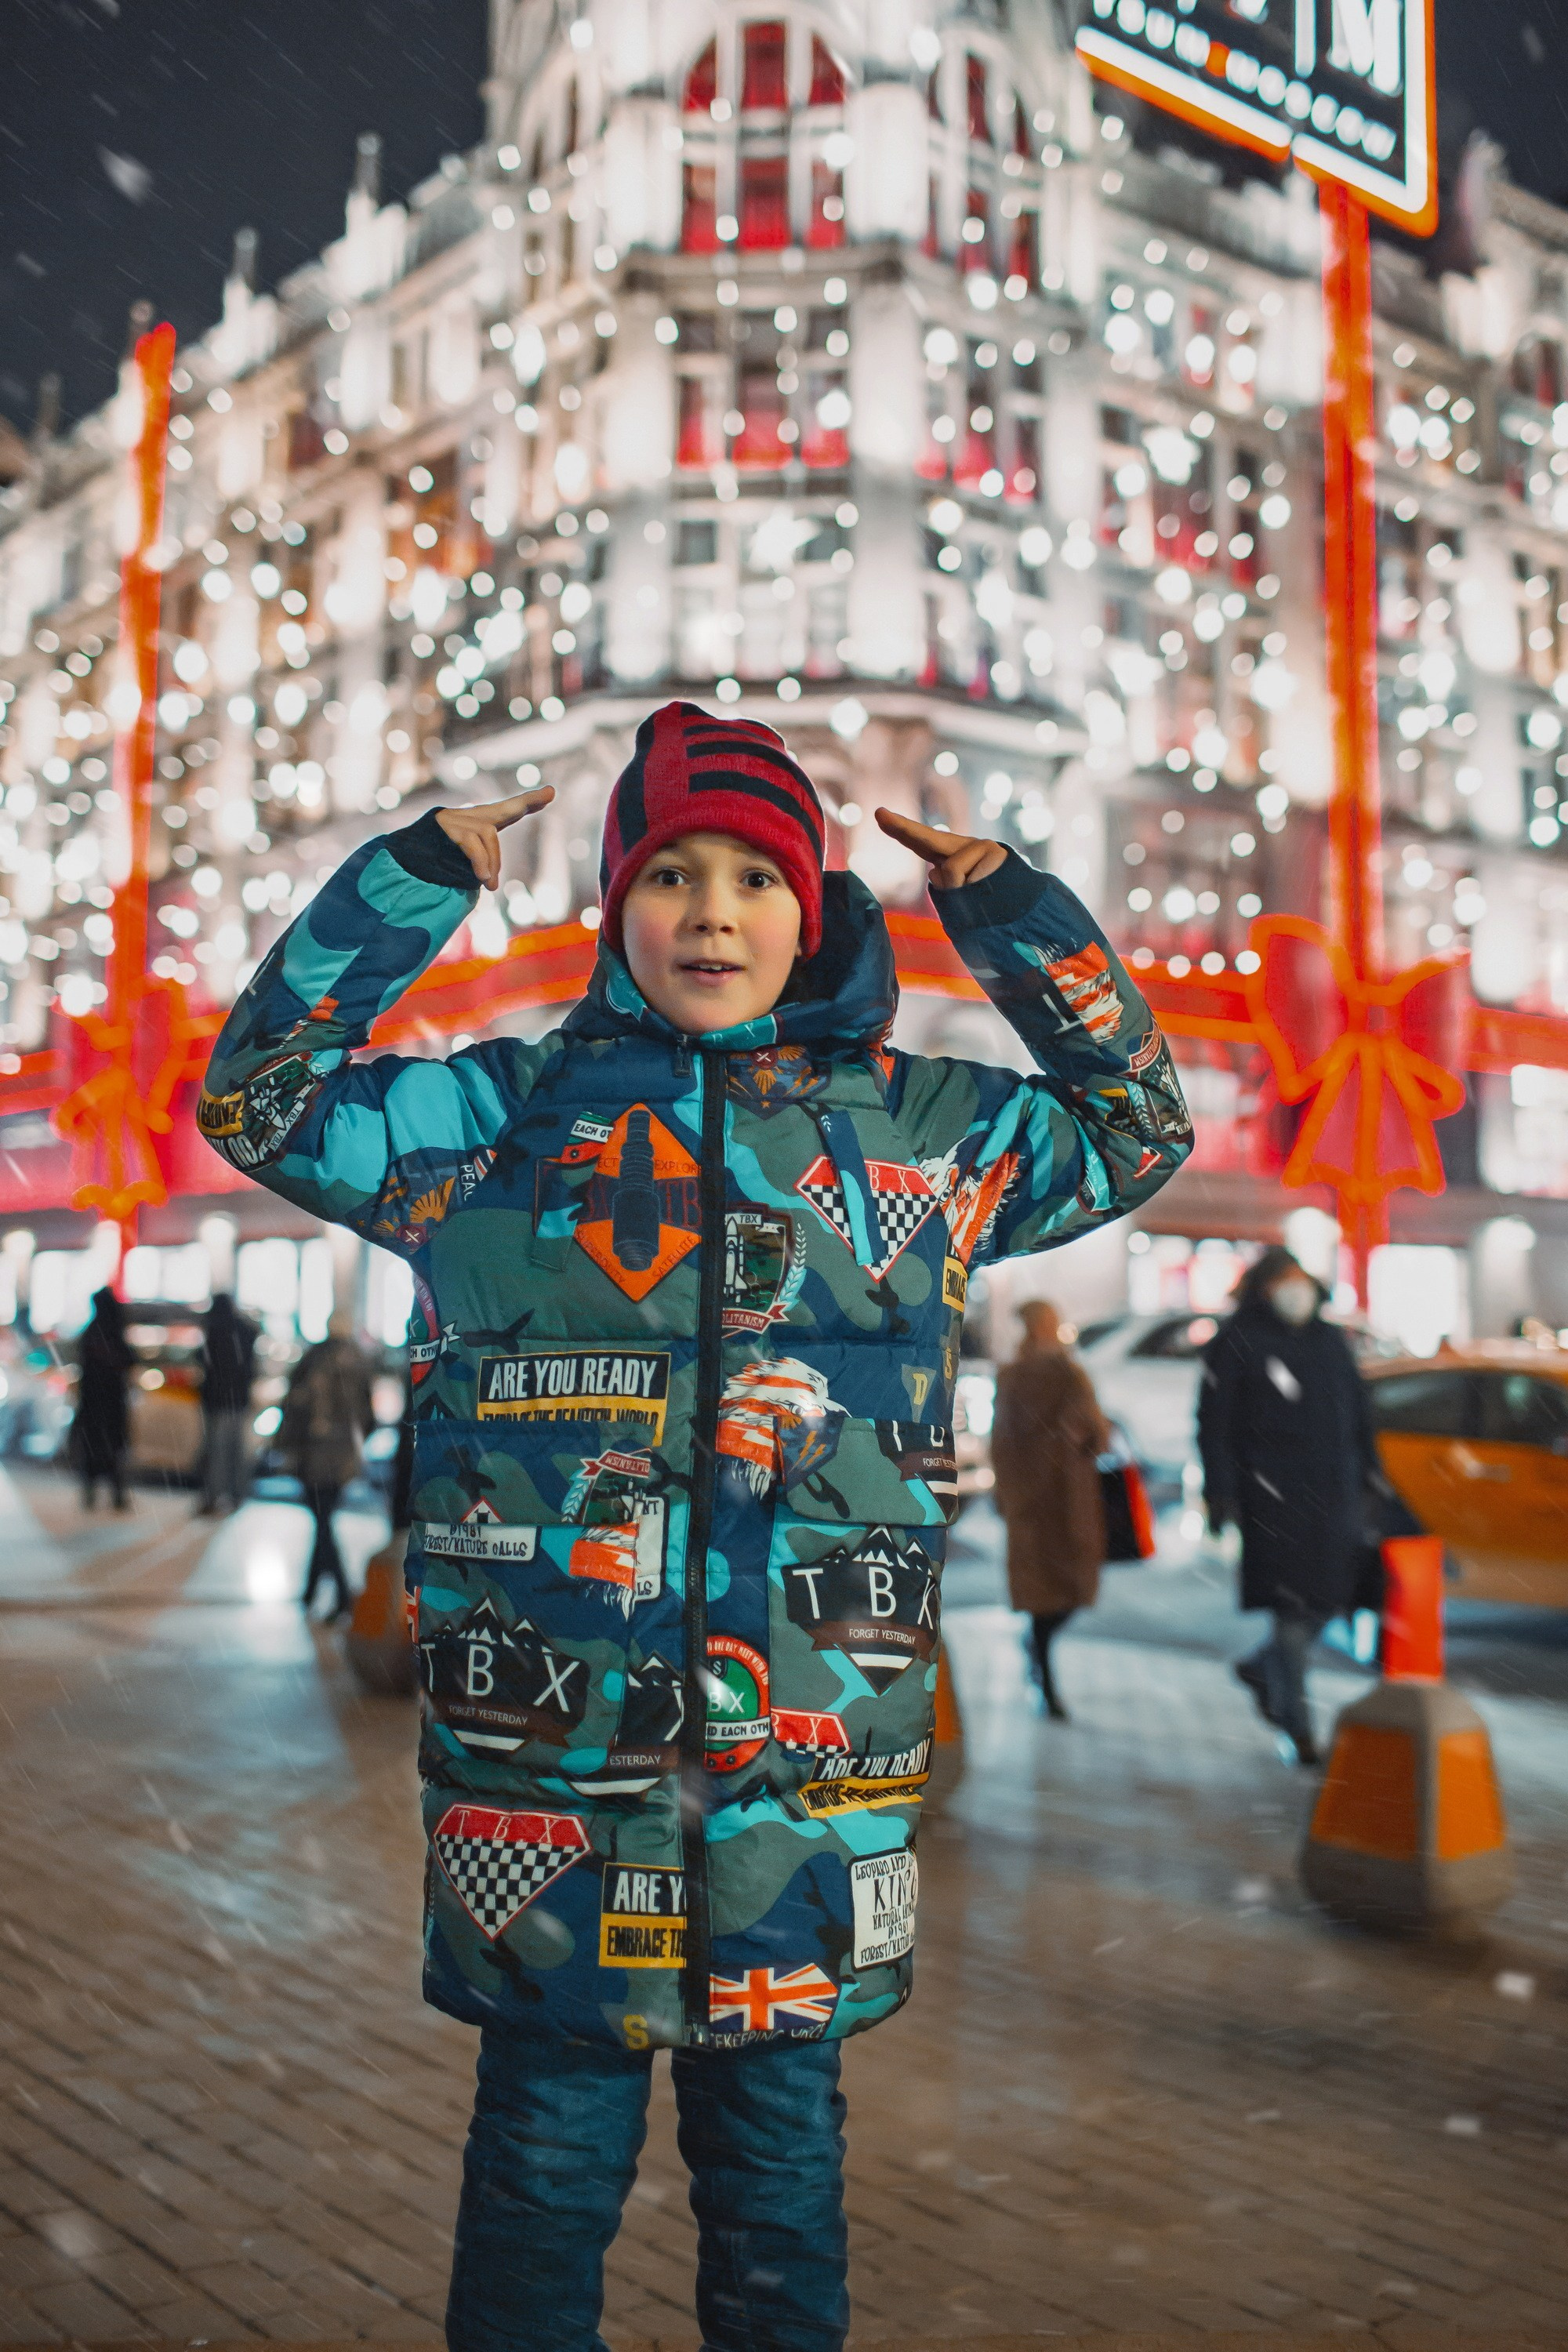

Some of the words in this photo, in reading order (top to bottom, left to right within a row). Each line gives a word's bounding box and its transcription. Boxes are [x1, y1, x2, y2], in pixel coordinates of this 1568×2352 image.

[574, 1123, 598, 1136] EACH
[740, 1215, 757, 1224] TBX
[652, 1236, 695, 1279] SATELLITE
[488, 1363, 529, 1400] ARE
[534, 1358, 577, 1396] YOU
[581, 1357, 658, 1398] READY
[912, 1373, 928, 1406] D
[492, 1541, 528, 1558] CALLS
[848, 1628, 880, 1639] FORGET
[881, 1629, 916, 1646] YESTERDAY
[449, 1704, 476, 1718] FORGET
[477, 1708, 528, 1726] YESTERDAY
[721, 1726, 747, 1737] EACH
[609, 1755, 661, 1766] ESTERDAY
[888, 1737, 931, 1777] READY
[855, 1860, 890, 1881] LEOPARD
[890, 1855, 906, 1873] AND
[613, 1871, 662, 1914] ARE
[873, 1905, 902, 1930] NATURAL
[607, 1925, 667, 1958] EMBRACE
[622, 2014, 650, 2051] S
